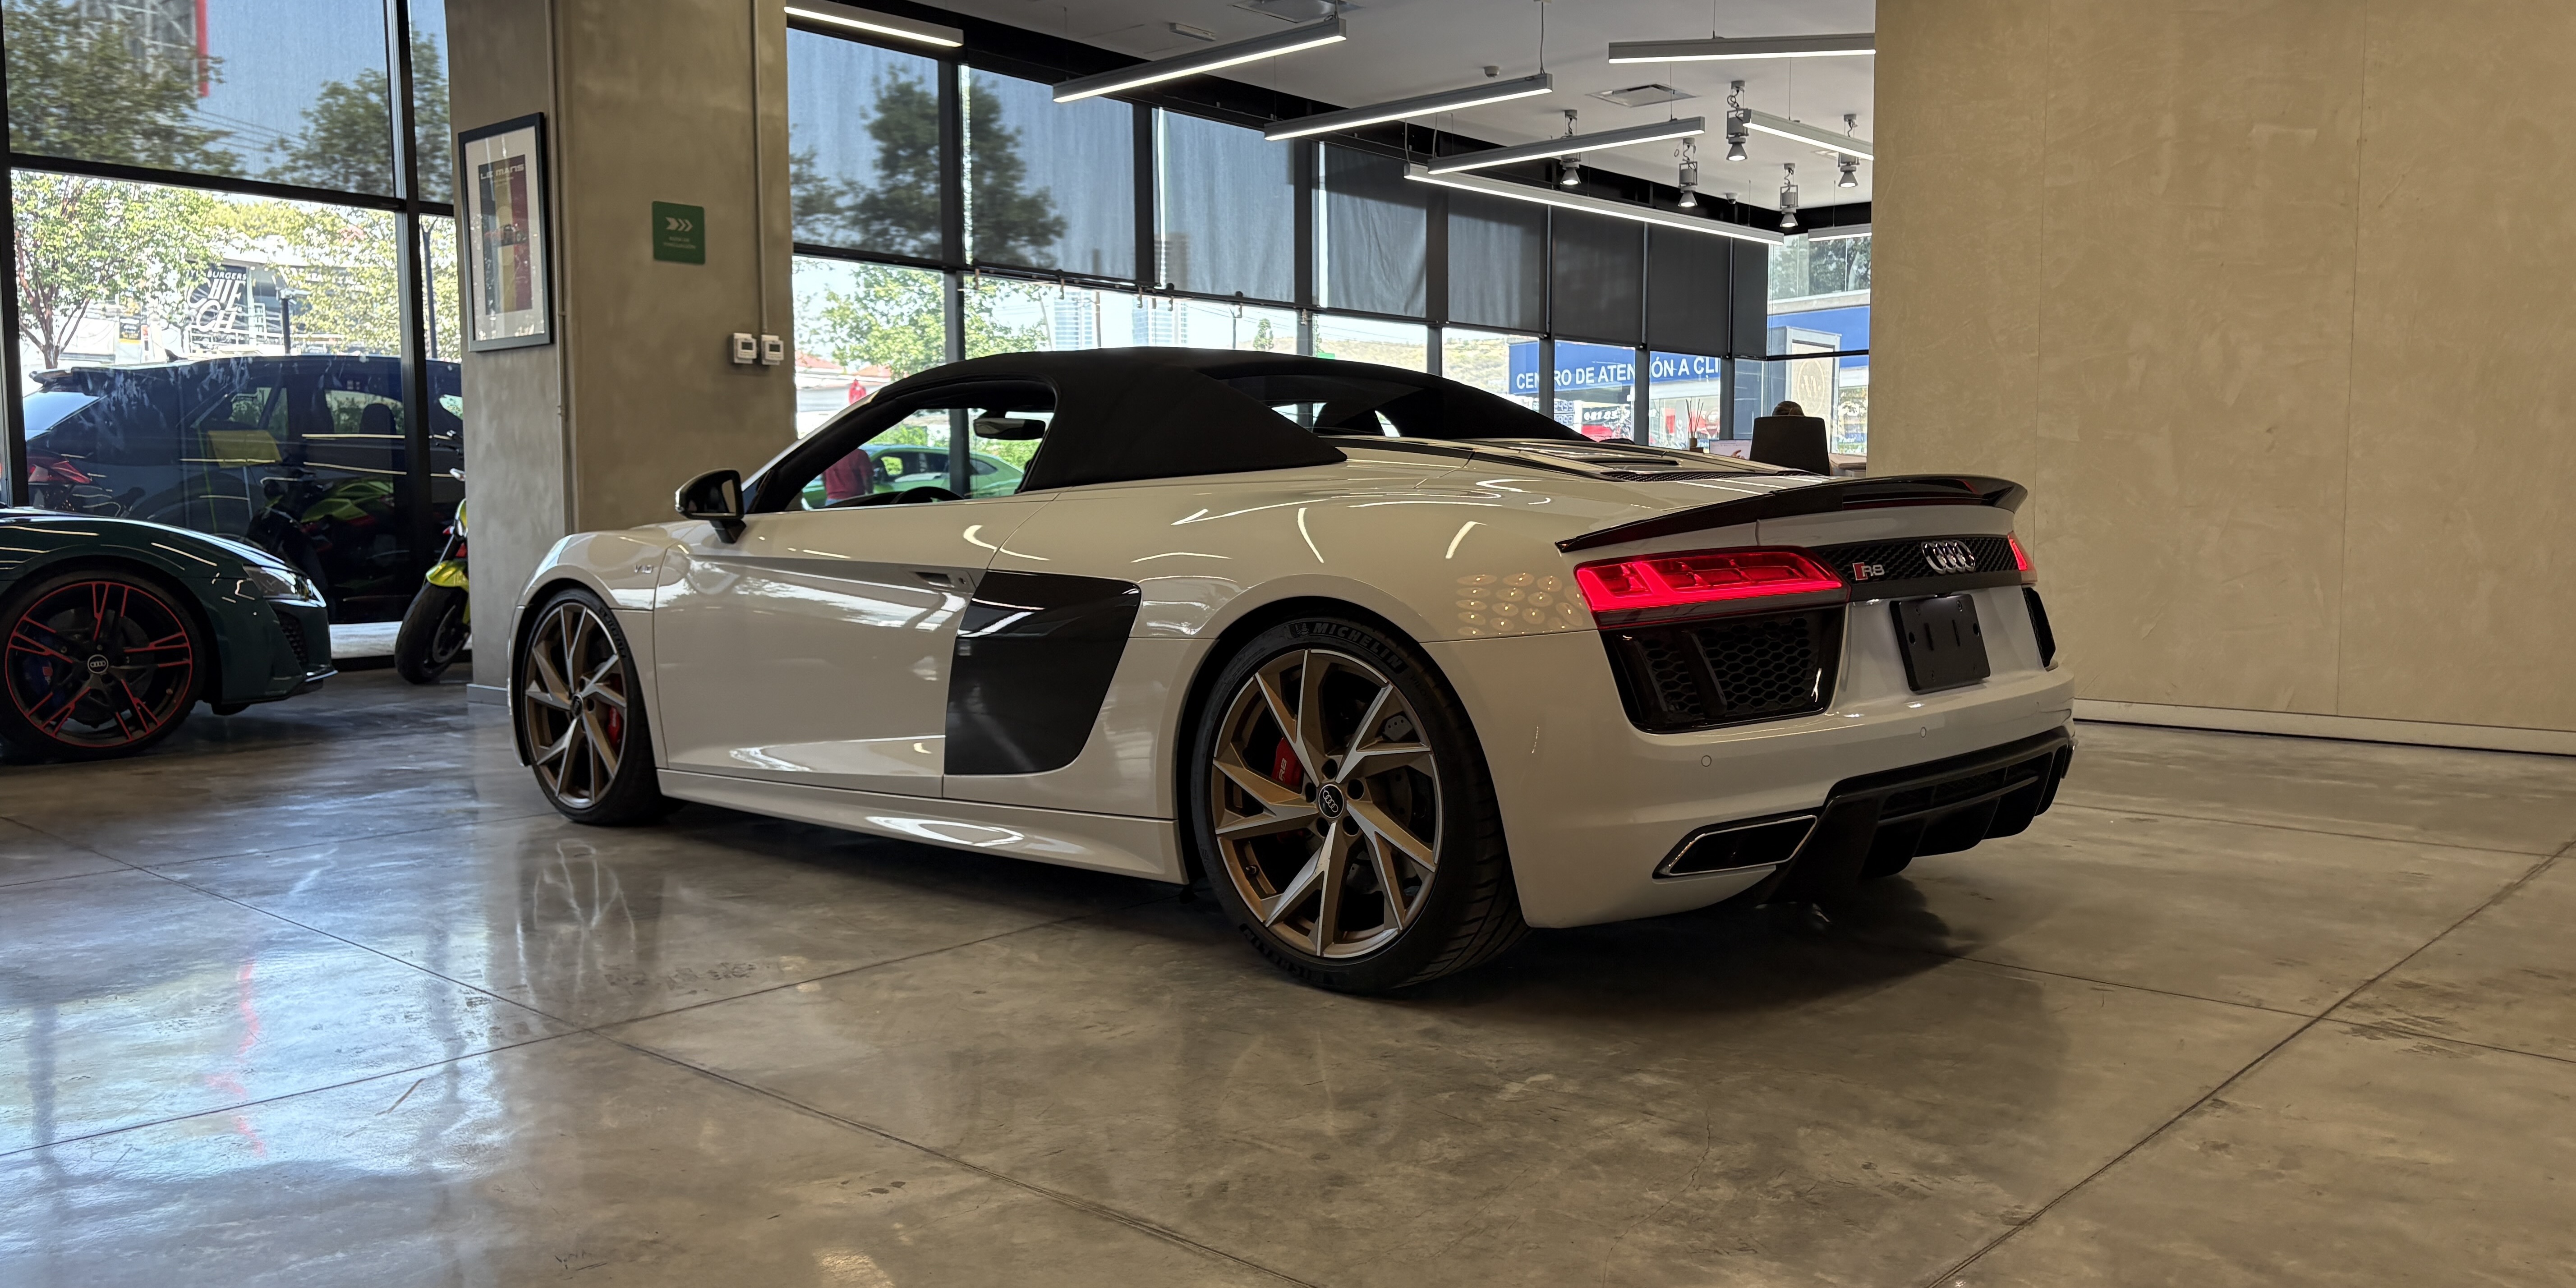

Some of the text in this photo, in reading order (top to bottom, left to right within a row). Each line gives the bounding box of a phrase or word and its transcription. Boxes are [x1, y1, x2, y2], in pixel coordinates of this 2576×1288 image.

[1576, 367, 1595, 384] DE
[1678, 358, 1690, 376] A
[1860, 564, 1885, 577] R8
[1313, 622, 1403, 669] MICHELIN
